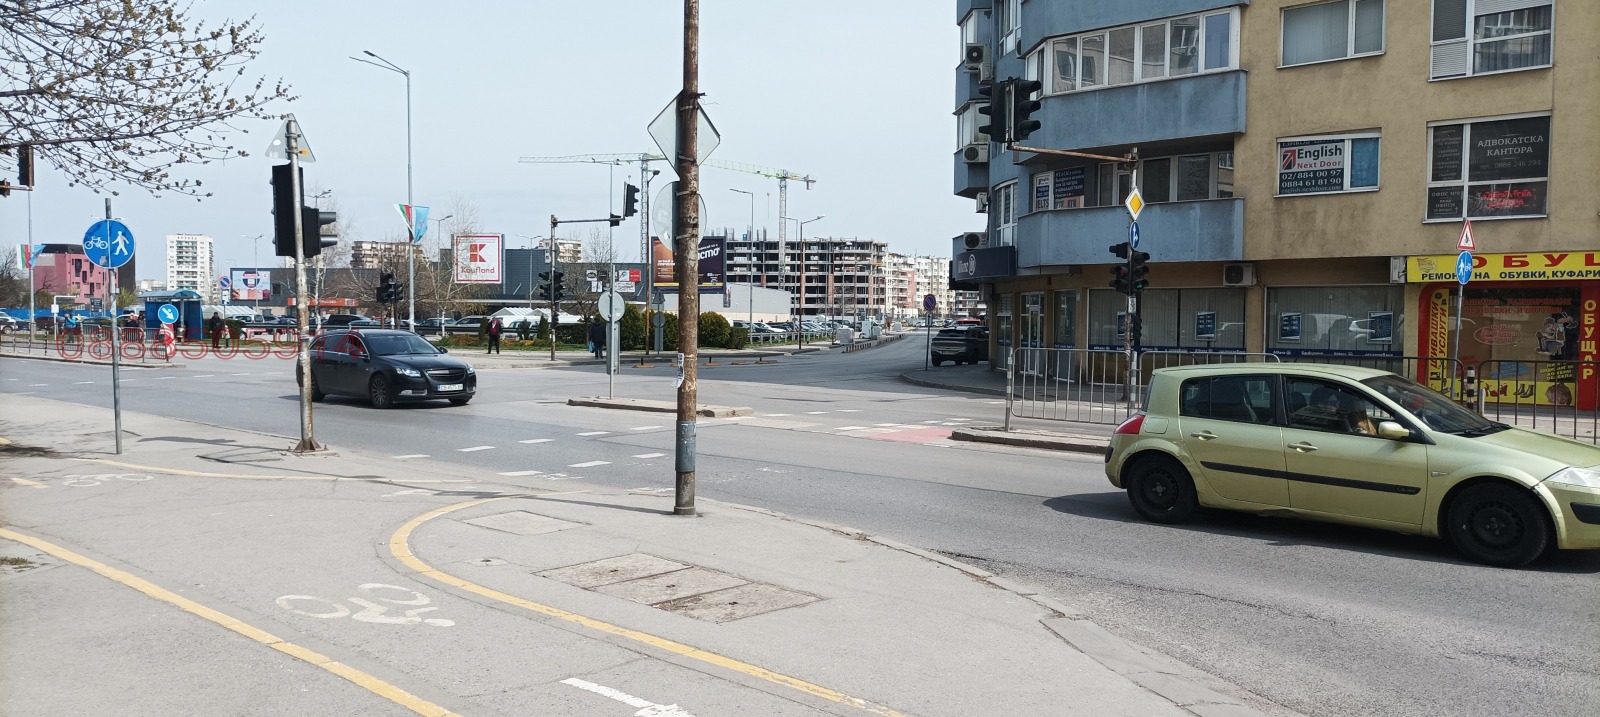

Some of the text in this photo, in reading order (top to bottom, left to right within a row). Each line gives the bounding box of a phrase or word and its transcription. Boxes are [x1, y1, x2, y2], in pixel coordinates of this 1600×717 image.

[1477, 135, 1544, 148] АДВОКАТСКА
[1297, 145, 1342, 160] English
[1487, 146, 1533, 157] КАНТОРА
[1320, 160, 1342, 168] Door
[1282, 171, 1314, 180] 02/884
[1281, 180, 1303, 188] 0884
[1330, 177, 1342, 185] 90
[461, 266, 495, 274] Kaufland
[1421, 272, 1457, 280] РЕМОН
[1430, 301, 1439, 369] ШИВАШКИ
[1438, 306, 1447, 356] УСЛУГИ
[1581, 299, 1597, 380] ОБУЩАР
